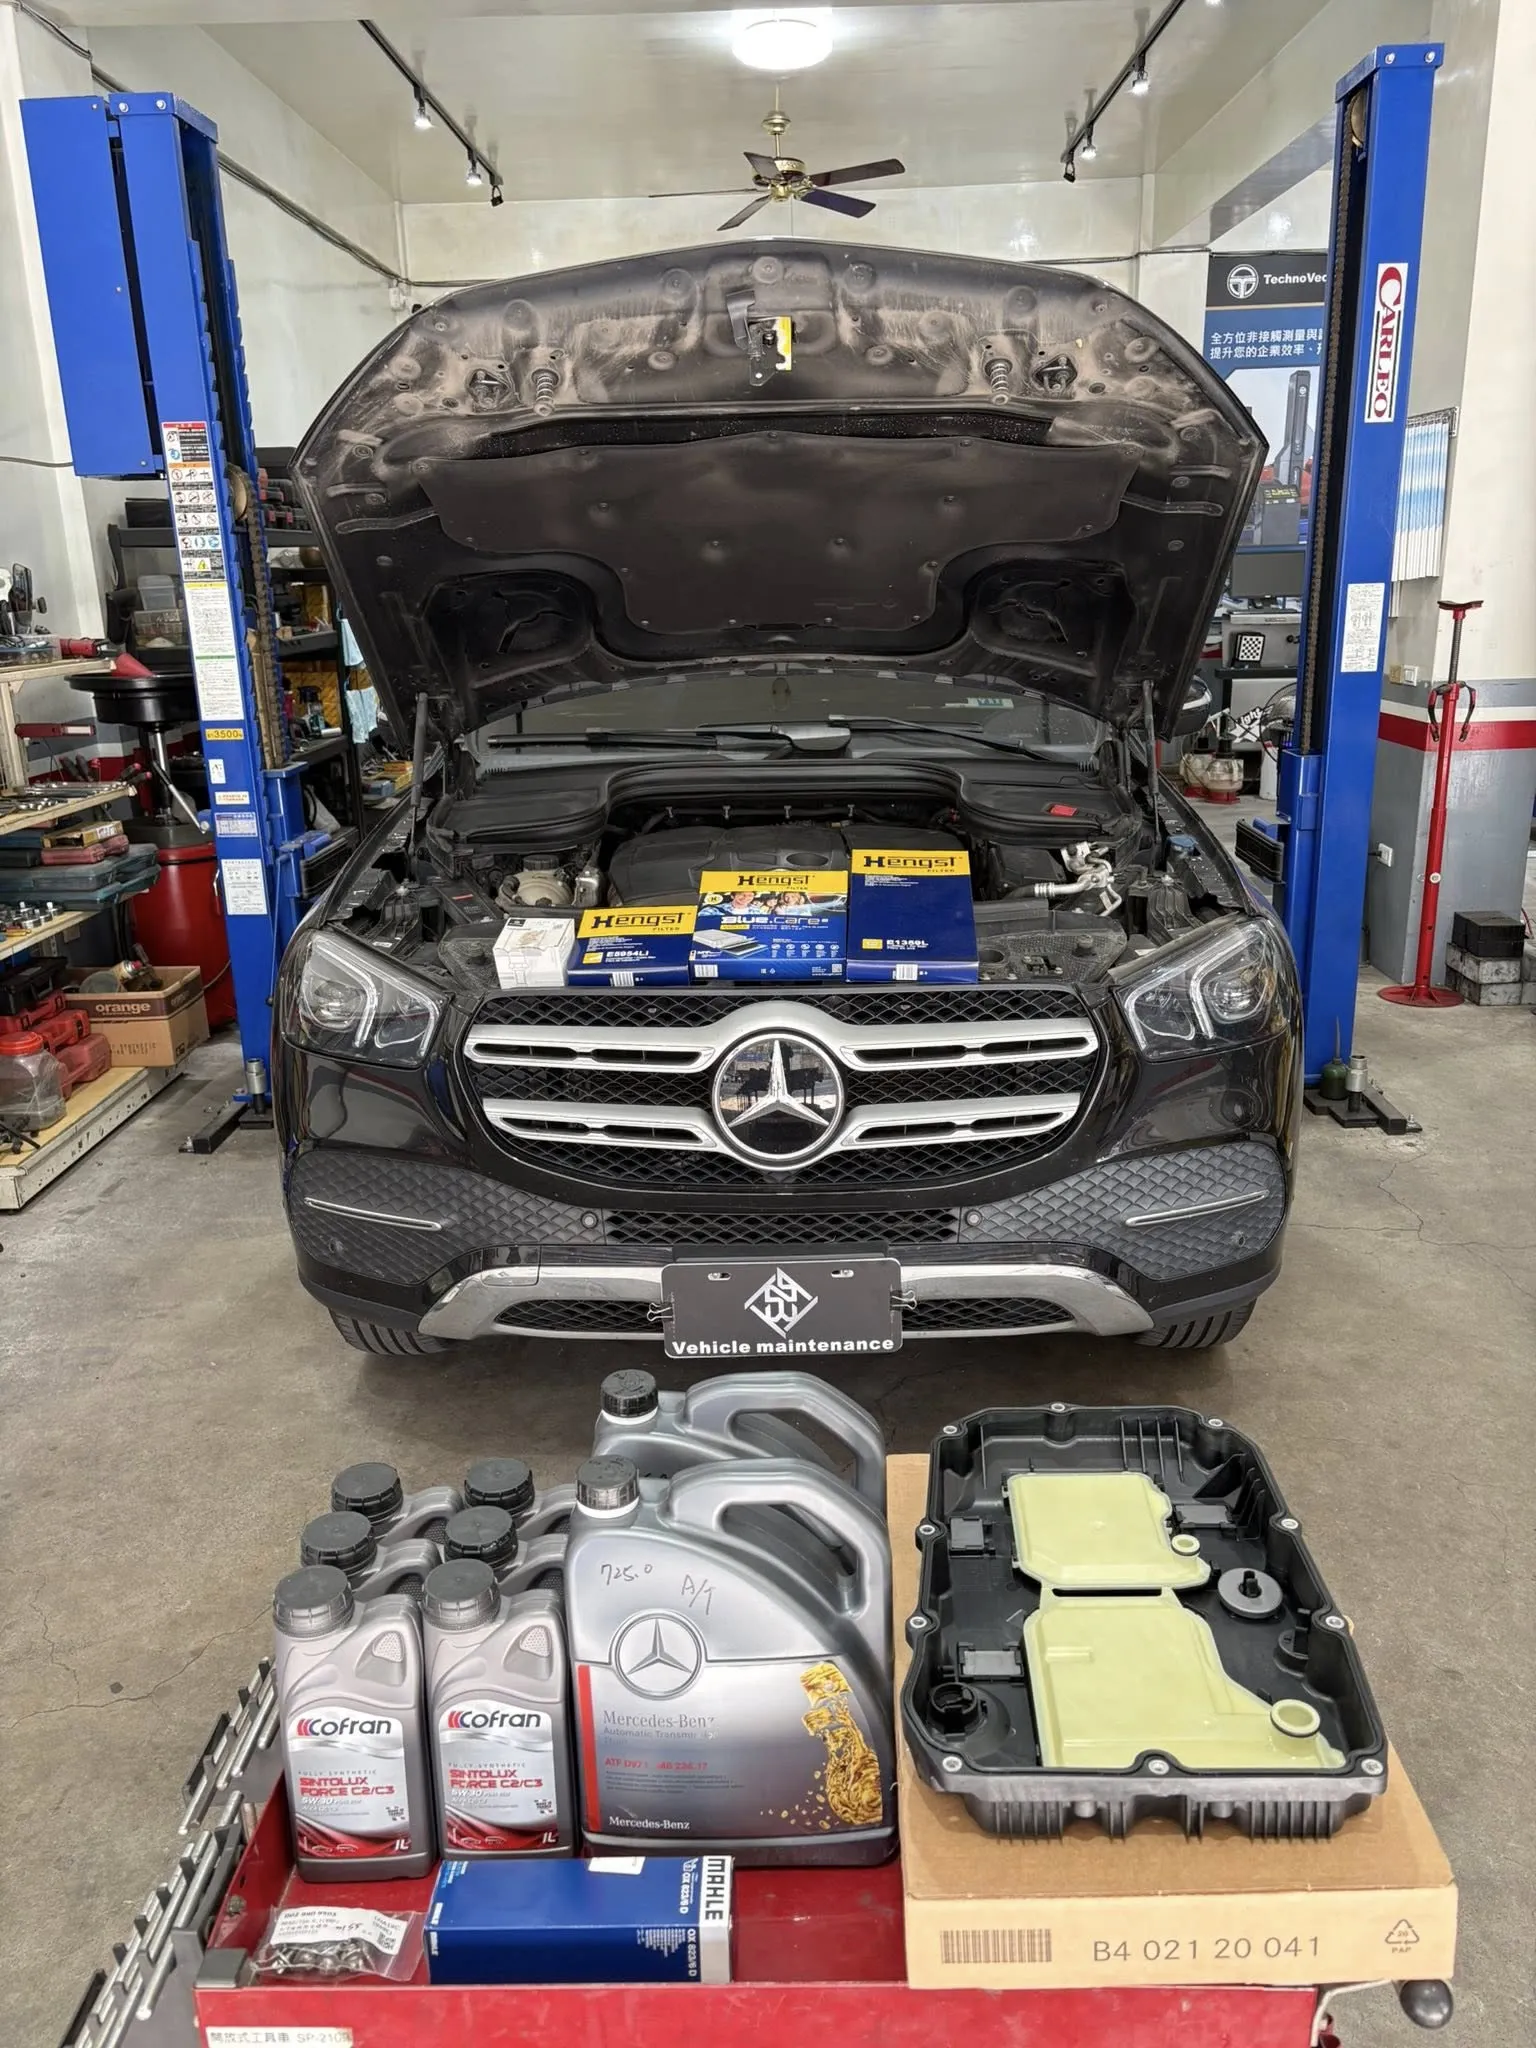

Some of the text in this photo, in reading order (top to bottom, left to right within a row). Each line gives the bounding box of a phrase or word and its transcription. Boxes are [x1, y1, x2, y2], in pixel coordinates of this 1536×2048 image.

[1374, 267, 1402, 418] CARLEO
[863, 855, 957, 868] Hengst
[737, 875, 810, 886] Hengst
[591, 913, 686, 929] Hengst
[95, 1003, 151, 1014] orange
[672, 1339, 894, 1355] Vehicle maintenance
[601, 1564, 653, 1586] 725.0
[459, 1710, 541, 1728] Cofran
[308, 1718, 392, 1737] Cofran
[603, 1727, 652, 1738] Automatic
[449, 1769, 518, 1778] SINTOLUX
[299, 1777, 369, 1786] SINTOLUX
[500, 1779, 543, 1789] C2/C3
[300, 1786, 395, 1797] FORCE C2/C3
[608, 1816, 690, 1830] Mercedes-Benz
[542, 1832, 557, 1844] 1L
[394, 1839, 409, 1851] 1L
[705, 1858, 726, 1920] MAHLE
[1093, 1936, 1318, 1961] B4 021 20 041
